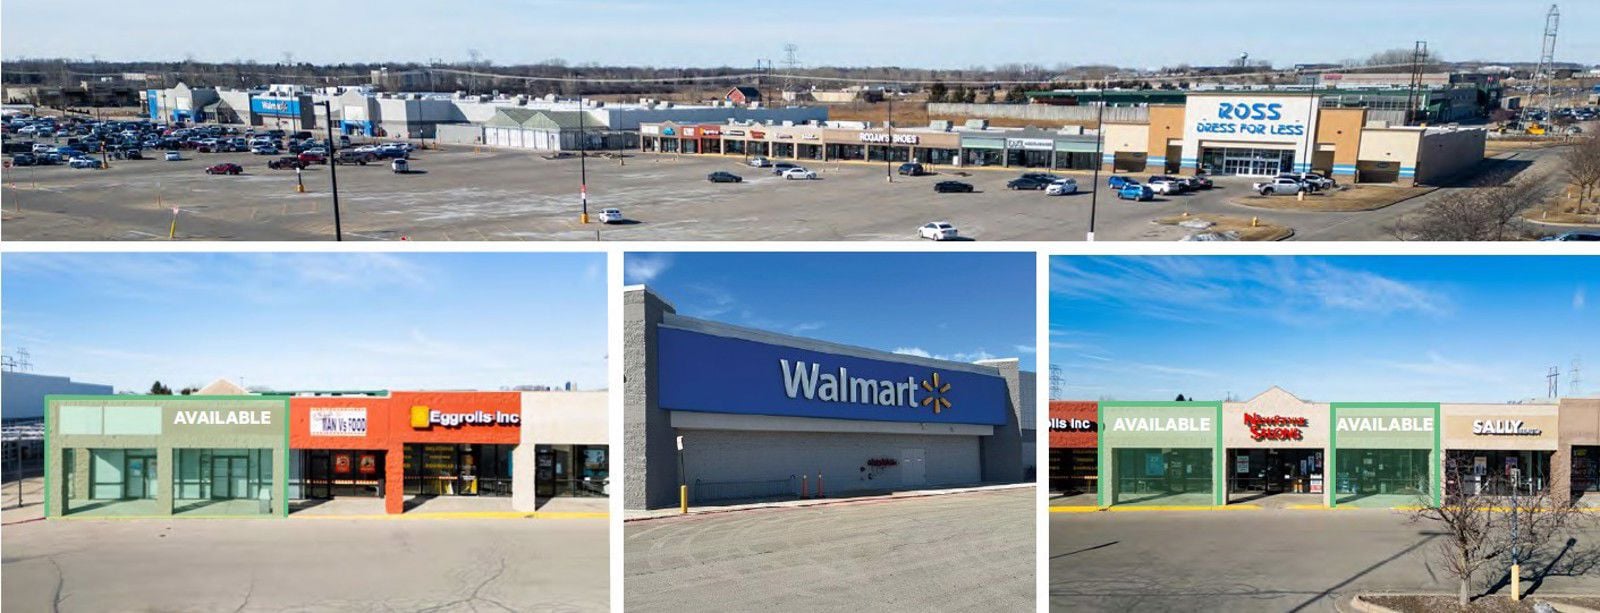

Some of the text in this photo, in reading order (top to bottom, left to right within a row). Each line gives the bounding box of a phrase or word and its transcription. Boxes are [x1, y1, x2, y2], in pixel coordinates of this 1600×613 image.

[1219, 103, 1281, 120] ROSS
[1197, 123, 1303, 135] DRESS FOR LESS
[892, 134, 917, 144] SHOES
[780, 358, 918, 408] Walmart
[429, 410, 519, 425] Eggrolls Inc
[1049, 418, 1090, 429] lls Inc
[1473, 420, 1521, 434] SALLY
